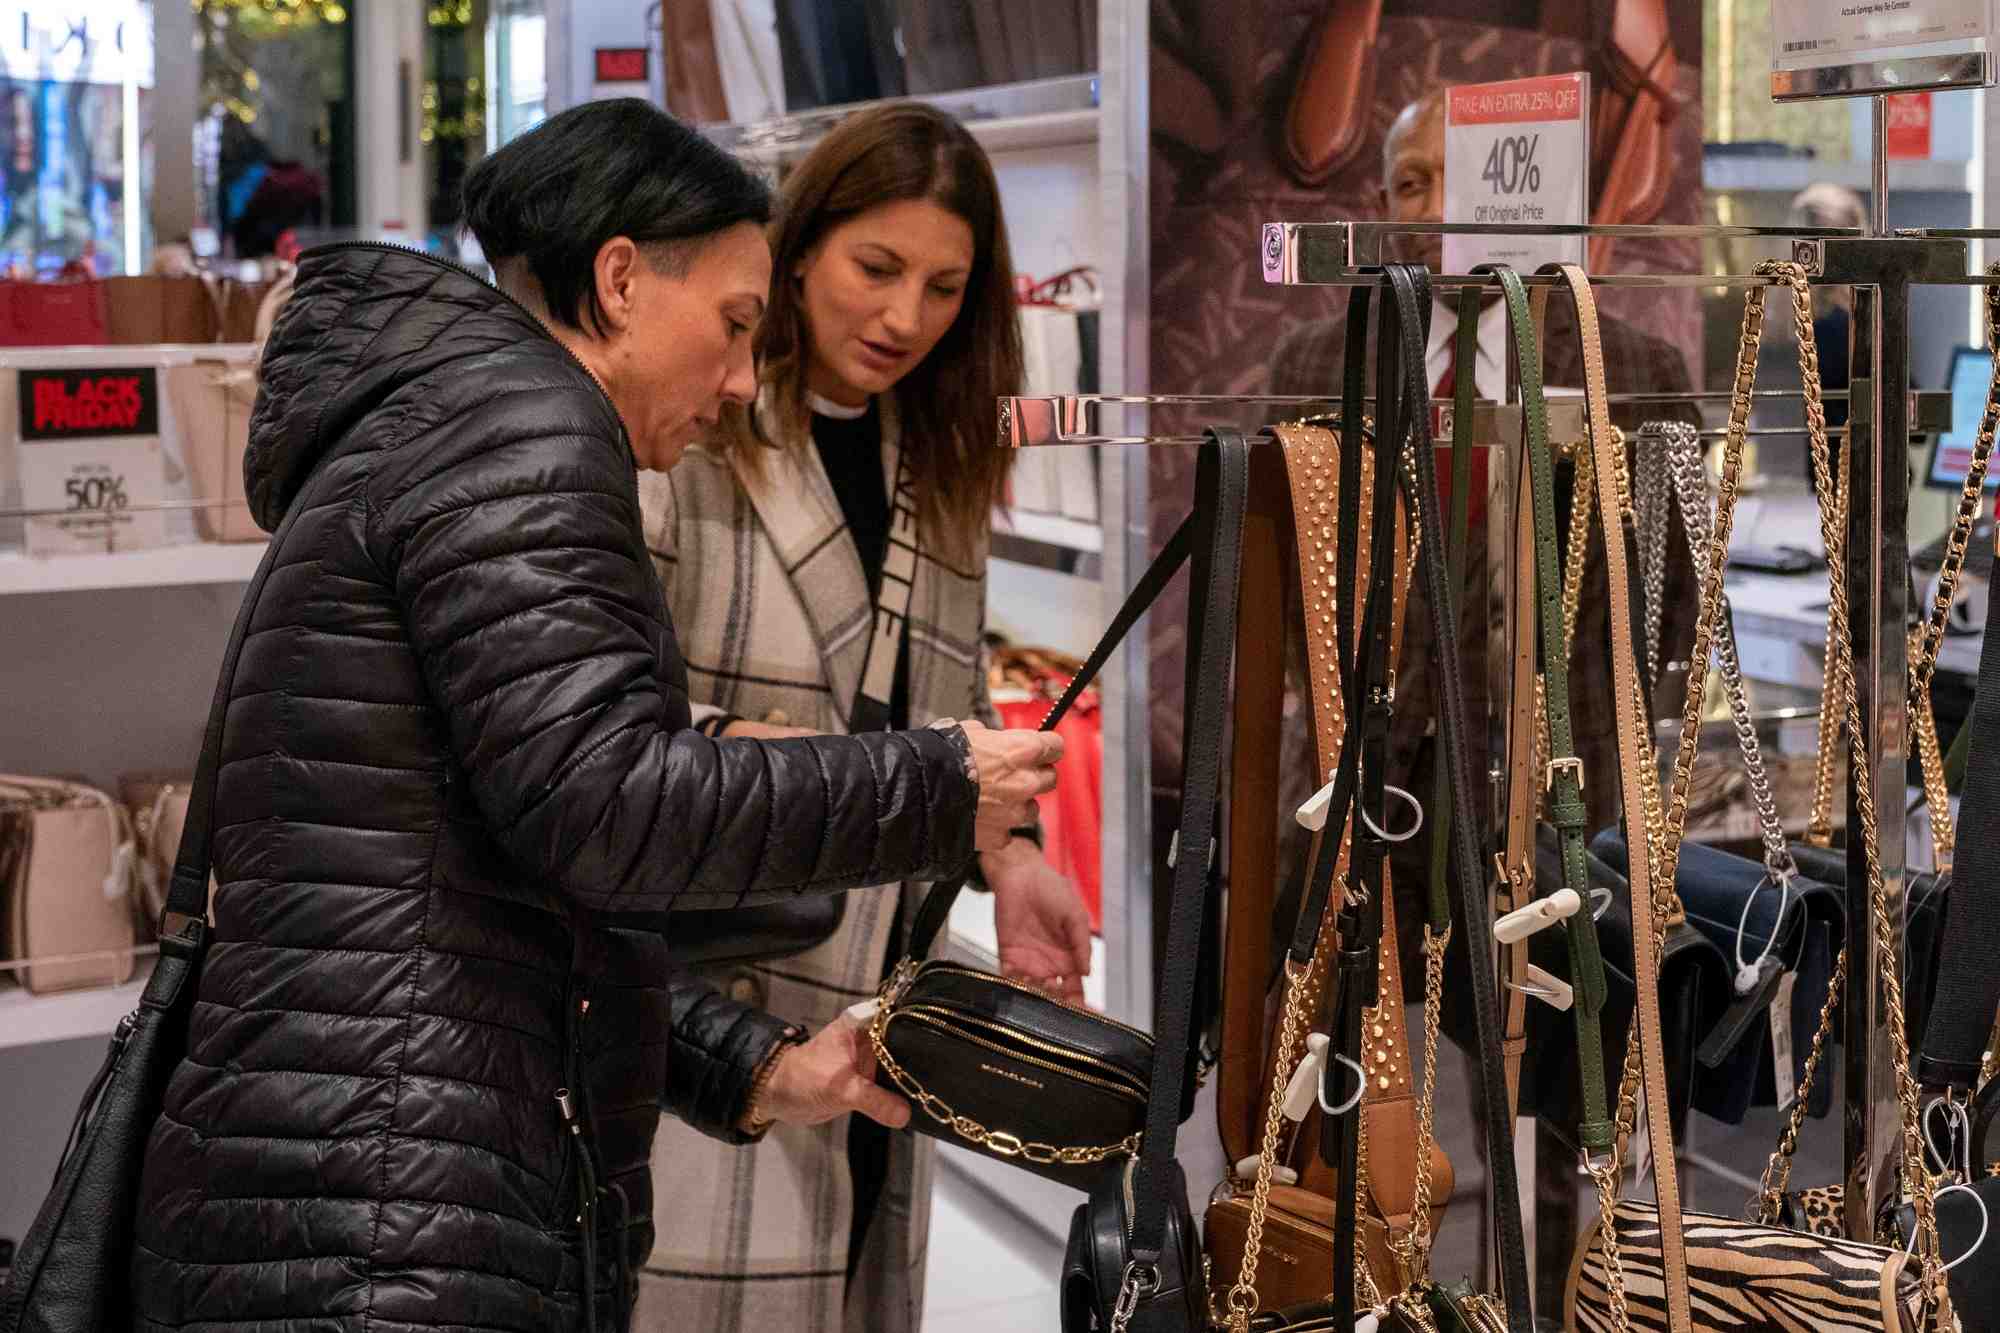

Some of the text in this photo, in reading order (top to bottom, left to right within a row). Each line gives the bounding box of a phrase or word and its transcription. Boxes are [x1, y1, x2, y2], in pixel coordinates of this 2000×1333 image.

[1841, 7, 1856, 16] Actual
[1857, 5, 1873, 15] Savings
[1455, 89, 1577, 114] TAKE AN EXTRA 25% OFF
[1482, 134, 1540, 194] 40%
[1475, 203, 1544, 224] Off Original Price
[33, 376, 140, 404] BLACK
[33, 398, 142, 431] FRIDAY
[66, 474, 128, 513] 50%
